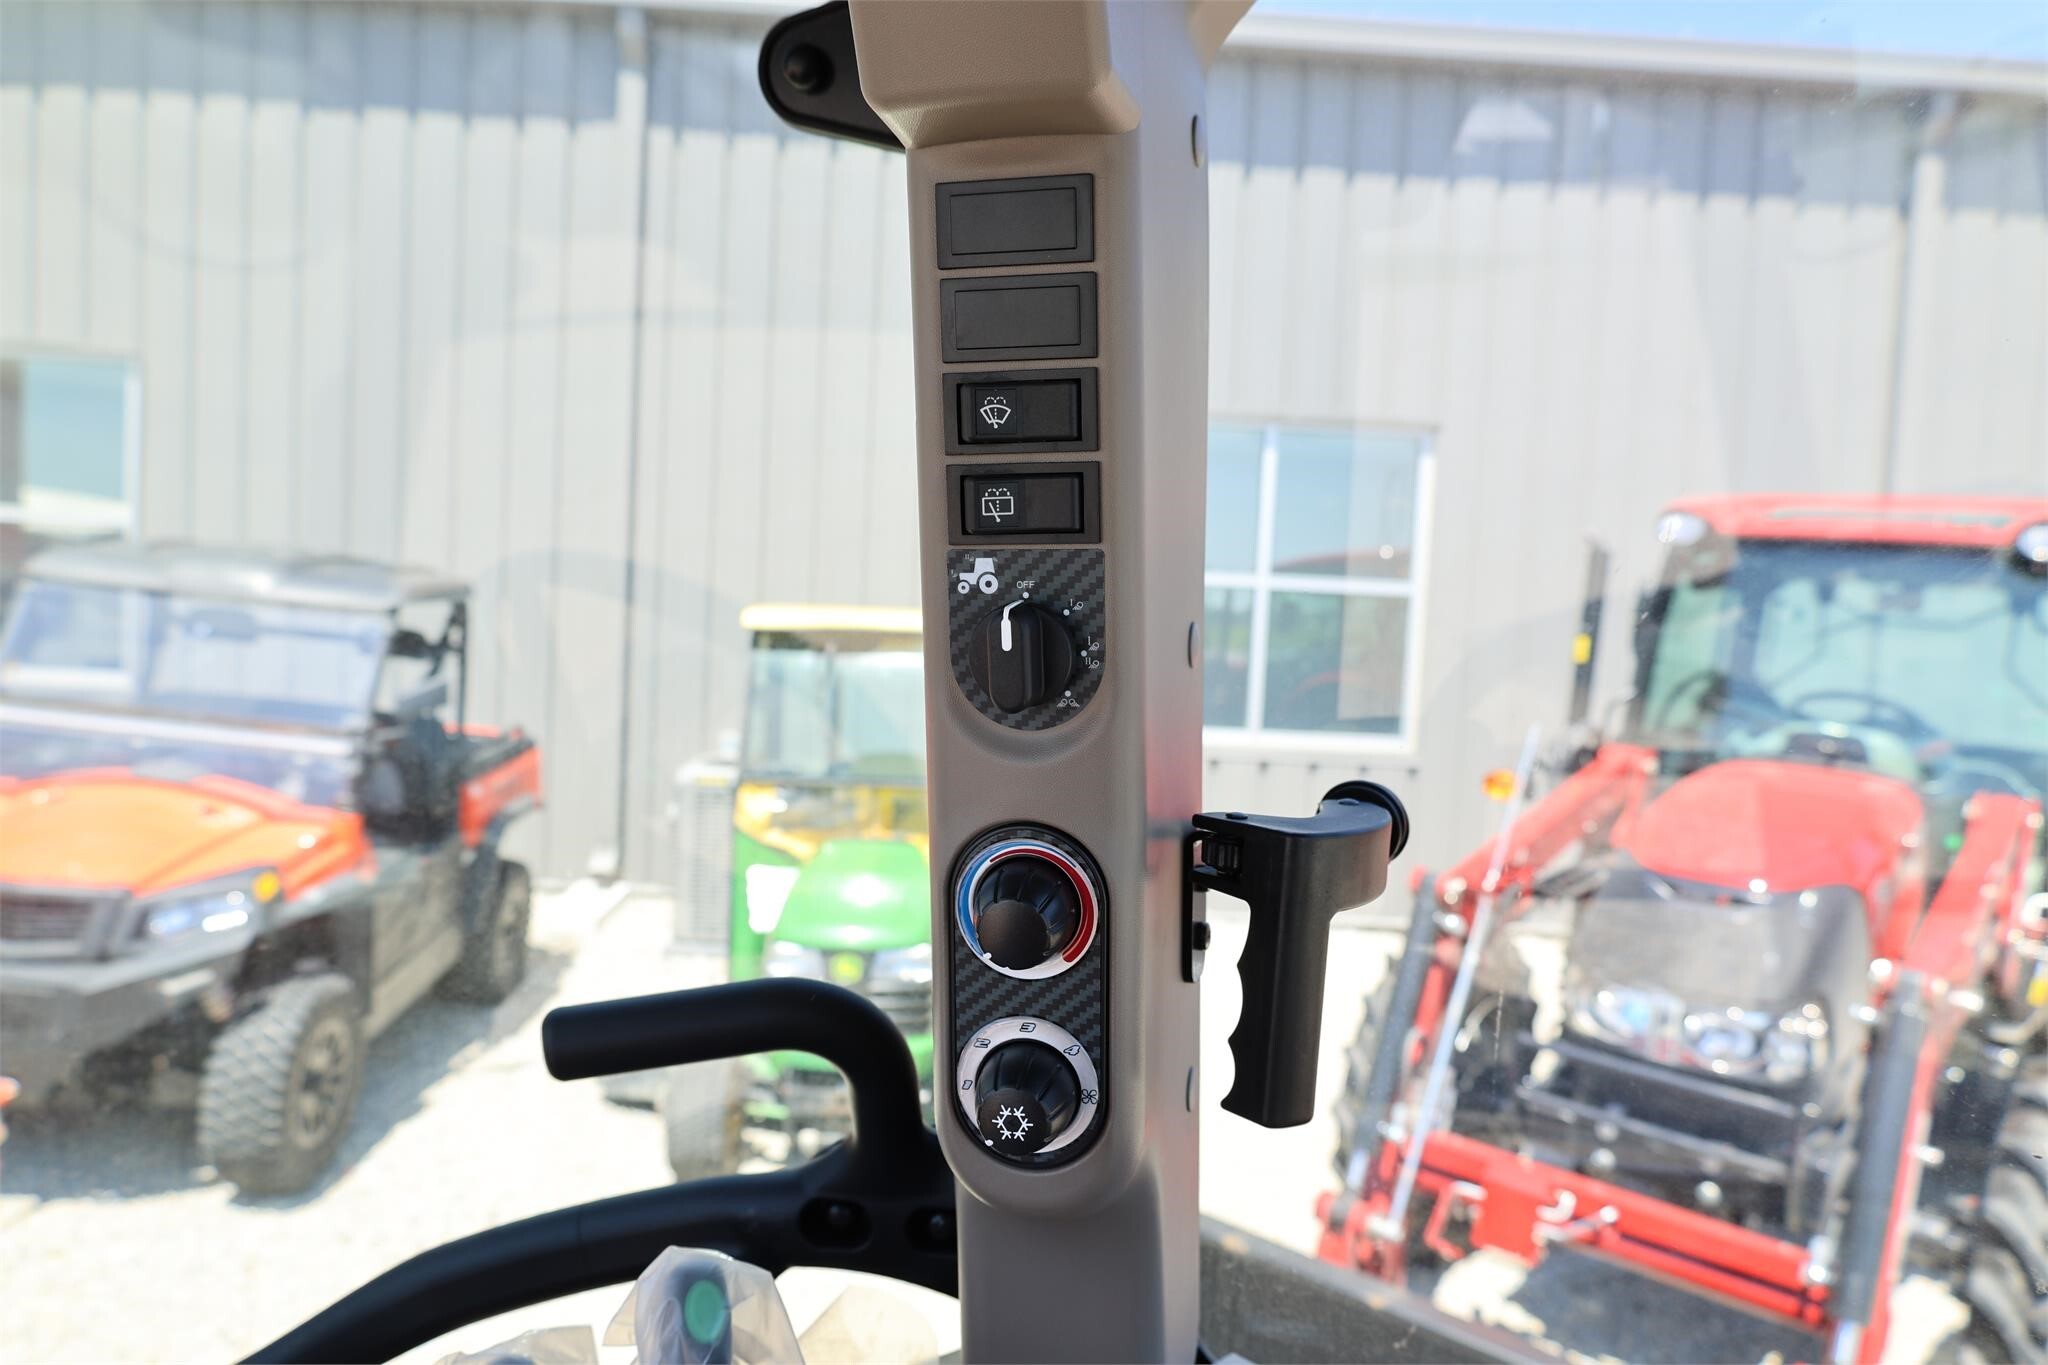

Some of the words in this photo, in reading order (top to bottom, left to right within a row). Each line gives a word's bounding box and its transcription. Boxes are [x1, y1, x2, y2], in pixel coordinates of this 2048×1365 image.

[1016, 580, 1036, 589] OFF
[1019, 1022, 1037, 1033] 3
[974, 1038, 991, 1048] 2
[1063, 1044, 1081, 1056] 4
[962, 1079, 973, 1090] 1
